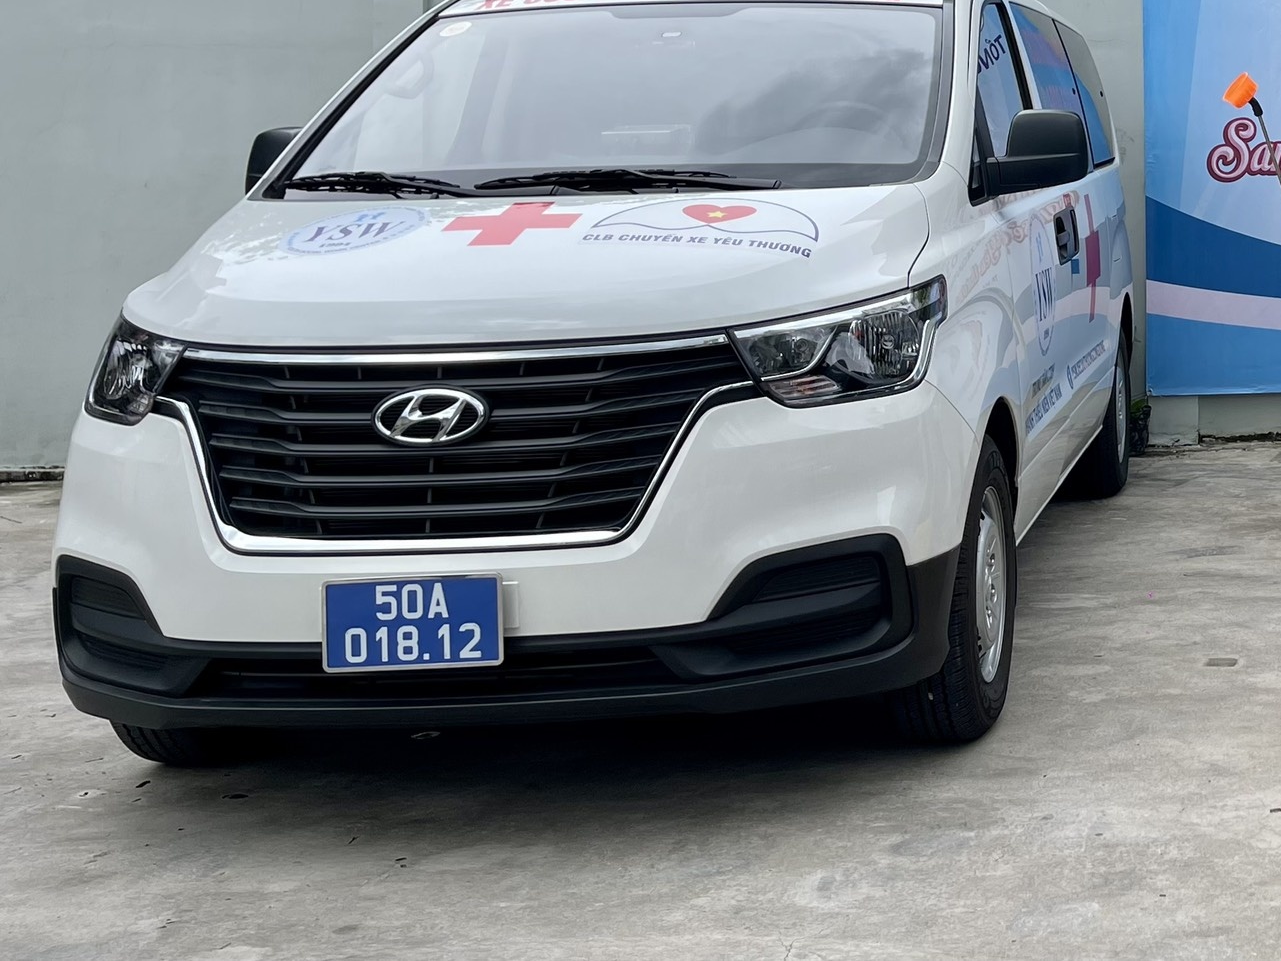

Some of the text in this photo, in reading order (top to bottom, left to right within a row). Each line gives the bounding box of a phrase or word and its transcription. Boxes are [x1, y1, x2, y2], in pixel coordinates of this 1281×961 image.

[304, 221, 406, 242] YSW
[713, 237, 744, 246] YÊU
[749, 239, 812, 258] THƯƠNG
[375, 582, 449, 621] 50A
[344, 622, 482, 663] 018.12
